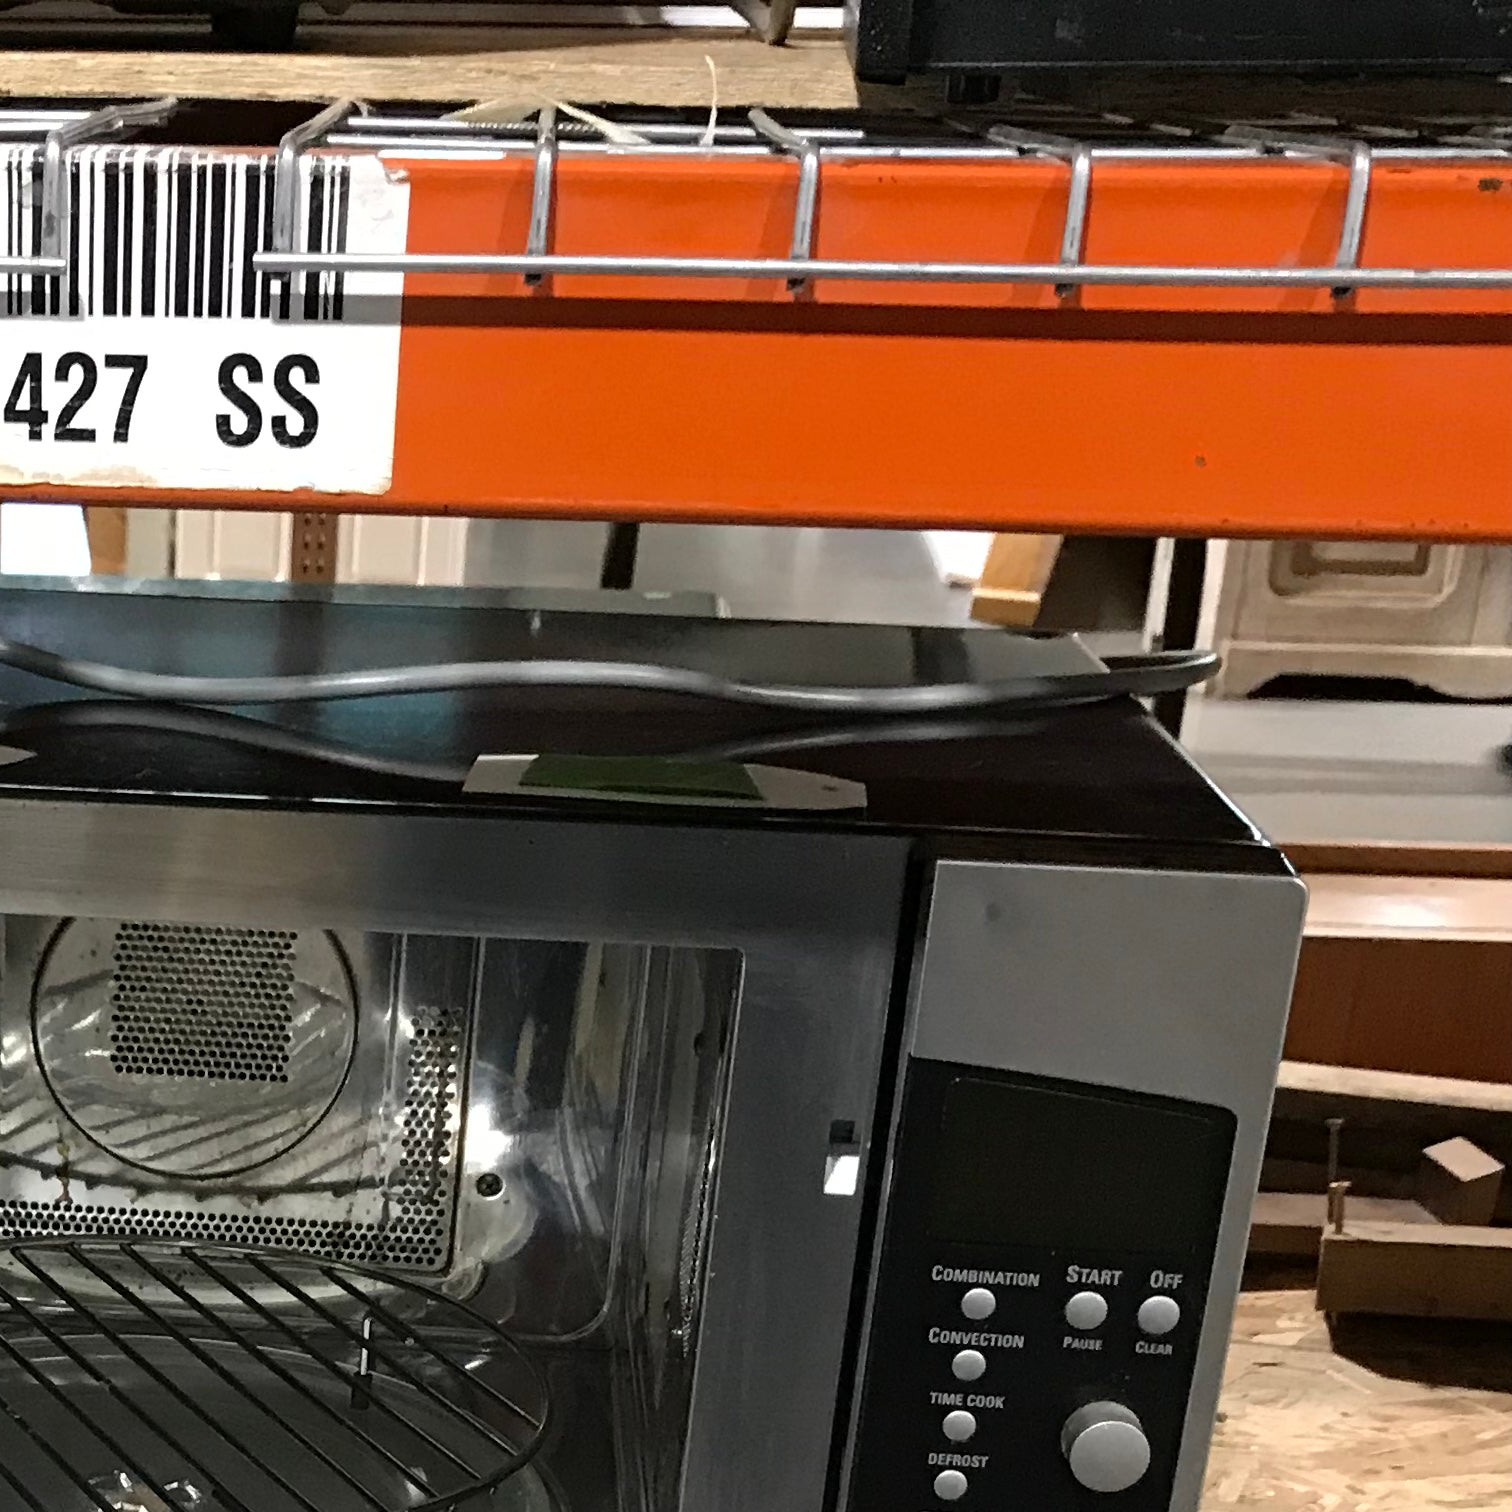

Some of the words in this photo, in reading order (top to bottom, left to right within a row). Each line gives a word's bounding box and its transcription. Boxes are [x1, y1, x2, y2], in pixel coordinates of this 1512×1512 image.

[215, 352, 321, 449] SS
[931, 1264, 1040, 1287] COMBINATION
[1066, 1264, 1123, 1287] START
[1150, 1268, 1184, 1290] OFF
[928, 1327, 1025, 1349] CONVECTION
[1063, 1336, 1104, 1352] PAUSE
[1135, 1341, 1174, 1356] CLEAR
[929, 1392, 963, 1406] TIME
[966, 1394, 1006, 1409] COOK
[927, 1452, 989, 1469] DEFROST
